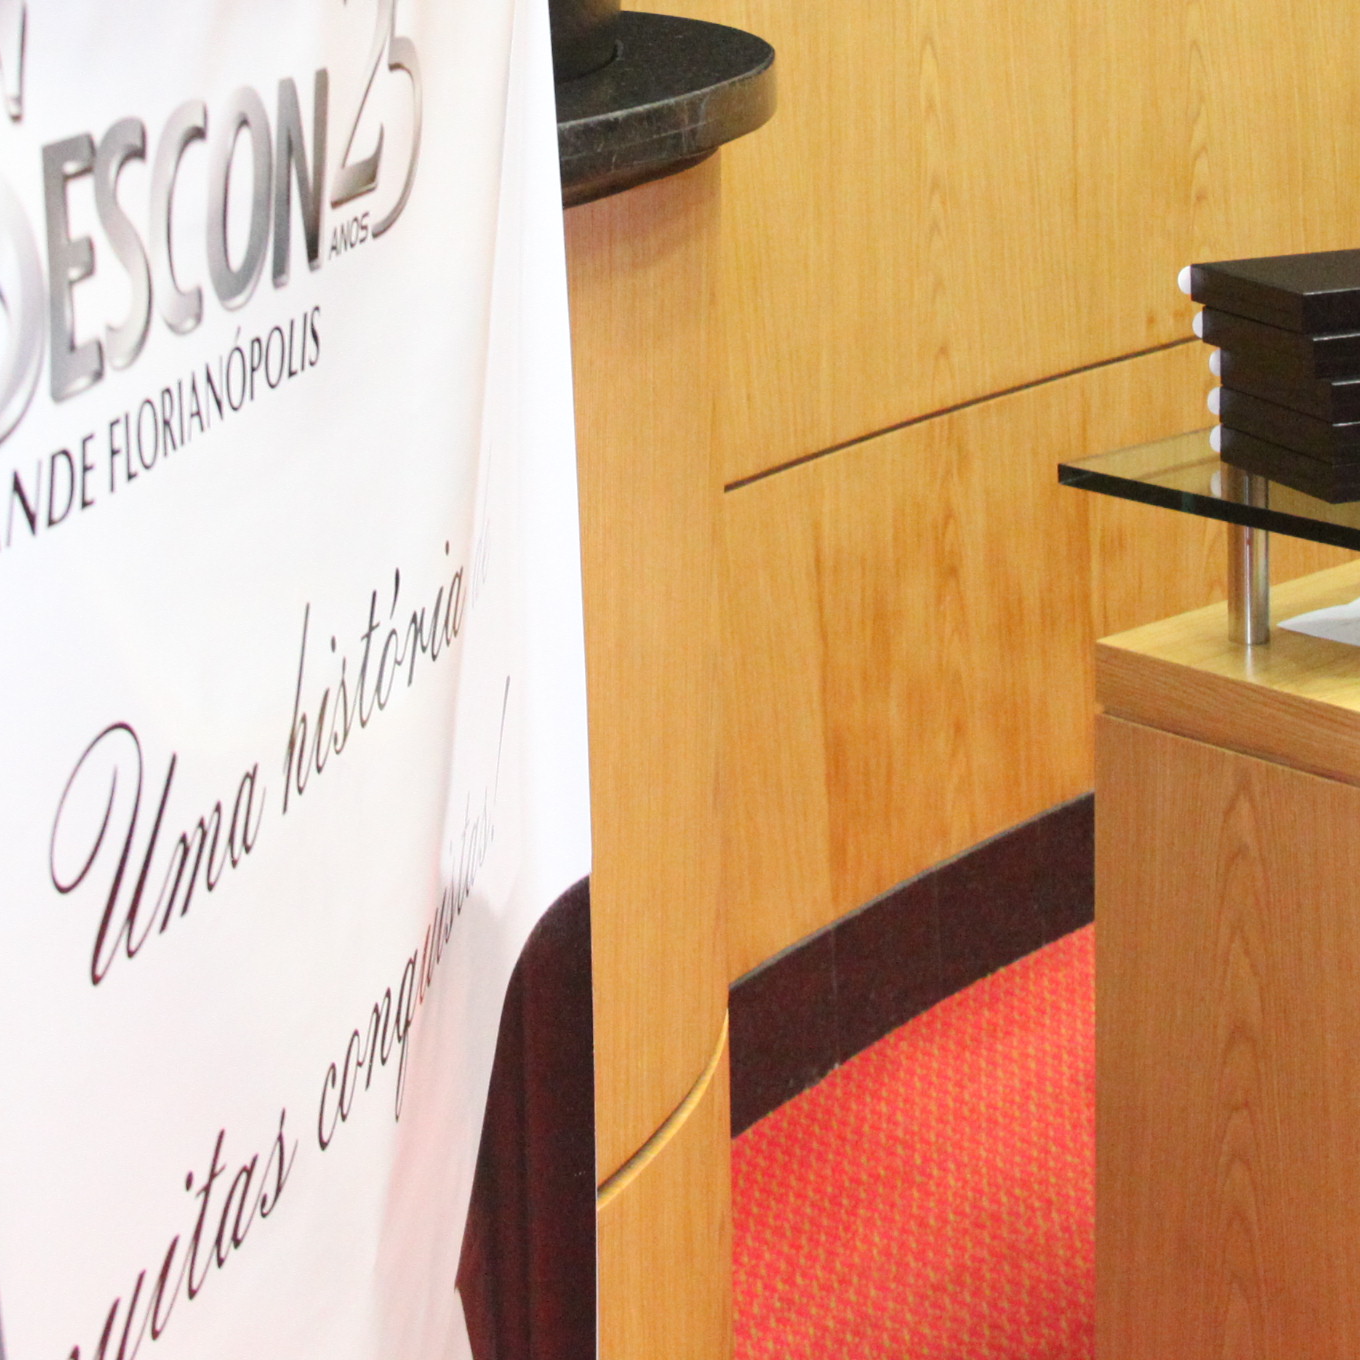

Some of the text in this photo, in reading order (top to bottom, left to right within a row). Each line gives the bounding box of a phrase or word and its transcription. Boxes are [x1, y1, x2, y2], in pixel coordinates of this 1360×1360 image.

[328, 212, 371, 261] ANOS
[108, 305, 322, 495] FLORIANÓPOLIS
[50, 721, 267, 986] Uma
[282, 539, 467, 816] história
[66, 1107, 298, 1360] uitas
